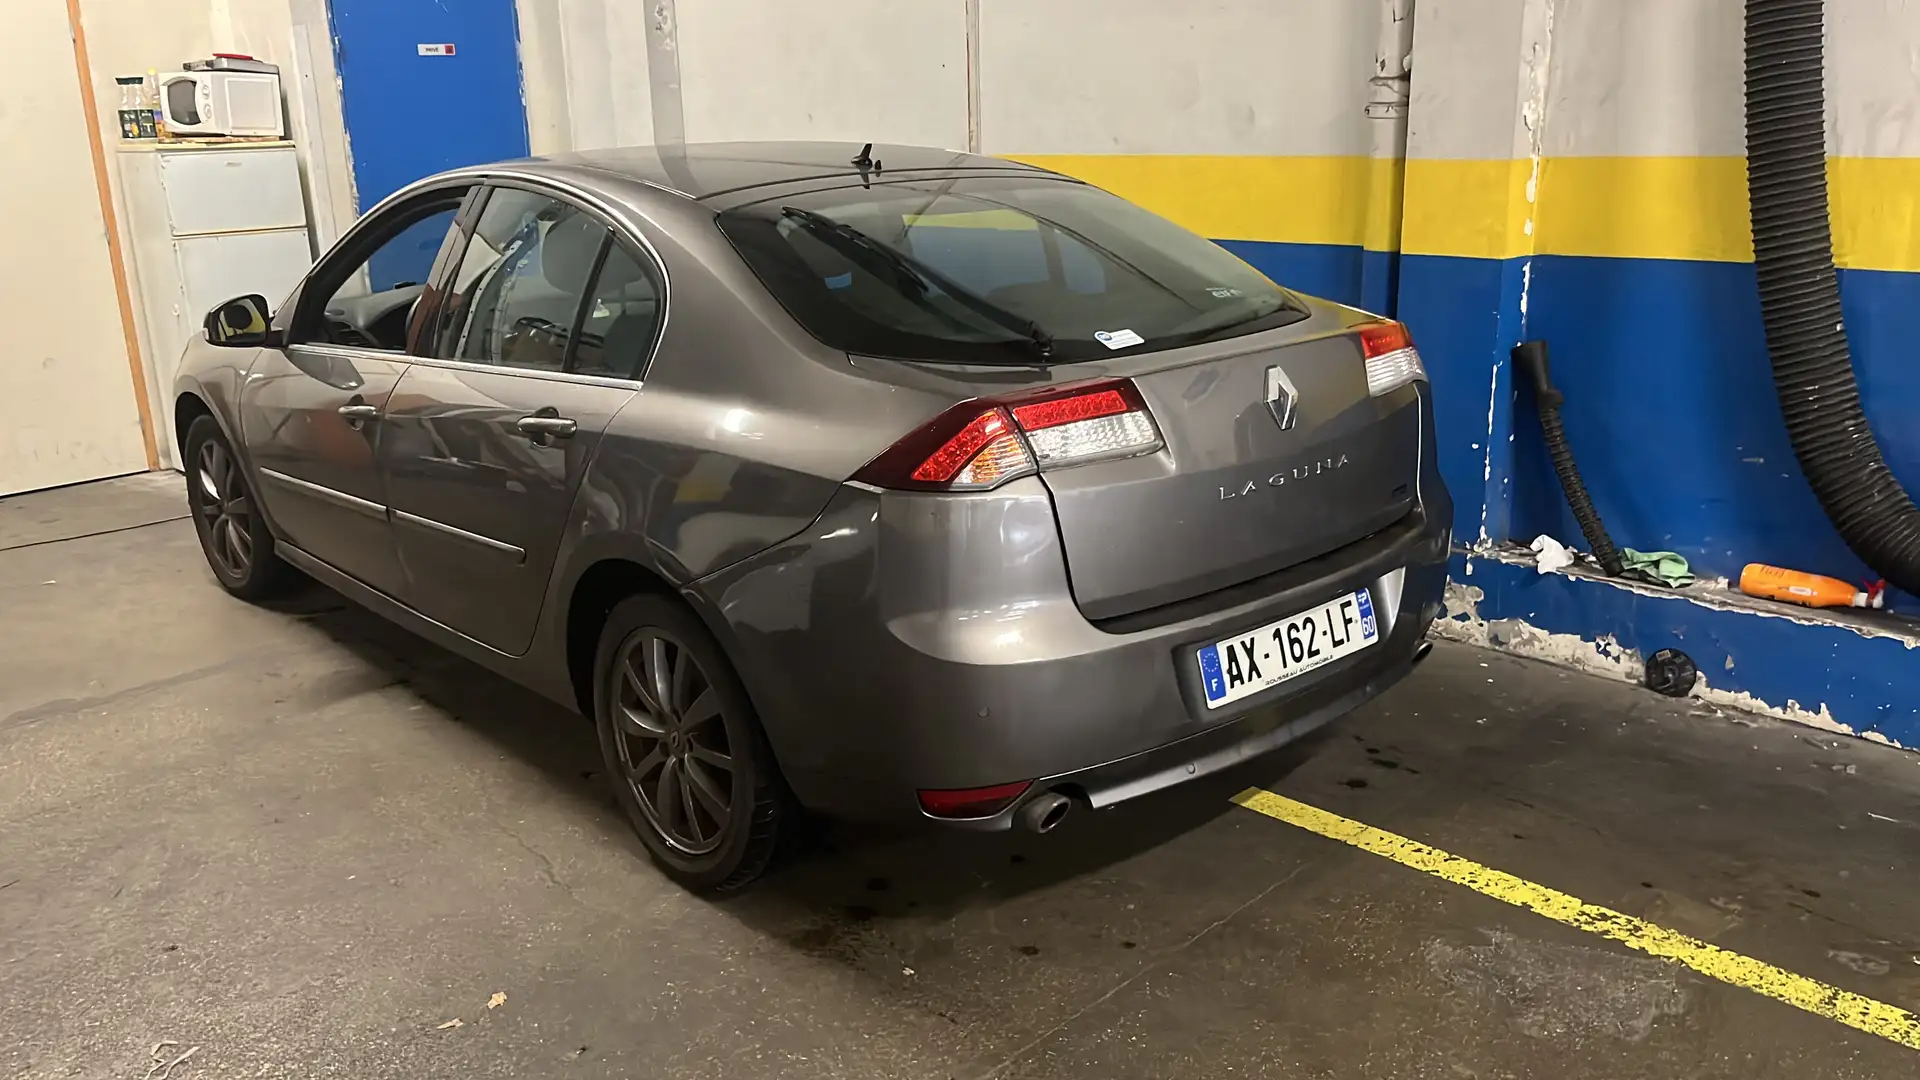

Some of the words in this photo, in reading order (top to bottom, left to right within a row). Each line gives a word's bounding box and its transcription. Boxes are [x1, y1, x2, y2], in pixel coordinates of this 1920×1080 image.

[1219, 454, 1350, 500] LAGUNA
[1361, 615, 1376, 636] 60
[1226, 599, 1354, 690] AX-162-LF
[1211, 678, 1218, 692] F
